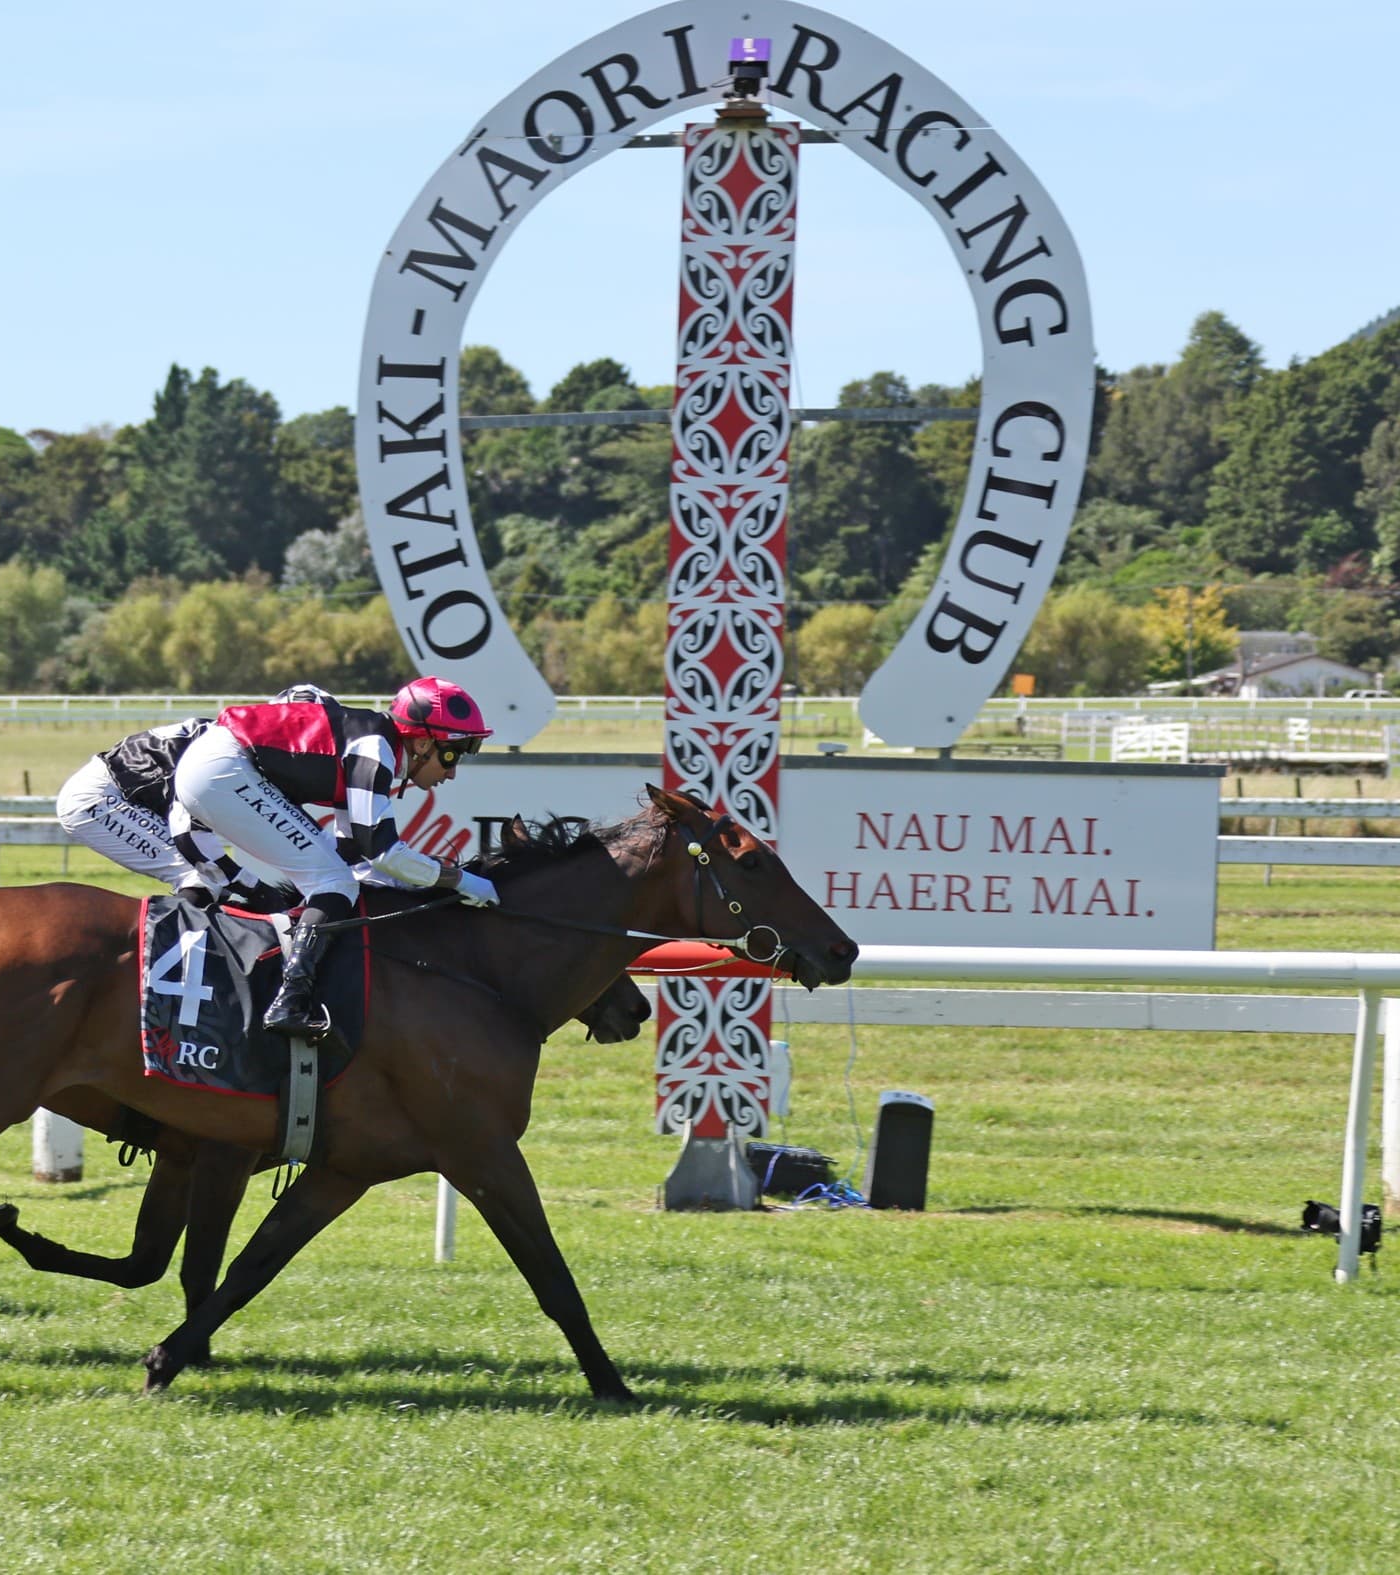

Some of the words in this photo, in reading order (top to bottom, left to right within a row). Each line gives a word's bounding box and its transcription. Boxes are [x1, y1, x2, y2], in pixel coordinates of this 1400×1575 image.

[767, 23, 1070, 348] RACING
[925, 400, 1067, 665] CLUB
[234, 784, 313, 851] L.KAURI
[257, 780, 319, 837] EQUIWORLD
[855, 812, 971, 852] NAU
[988, 815, 1112, 856] MAI.
[823, 871, 1012, 913] HAERE
[1031, 876, 1155, 917] MAI.
[147, 929, 214, 1027] 4
[176, 1041, 219, 1070] RC
